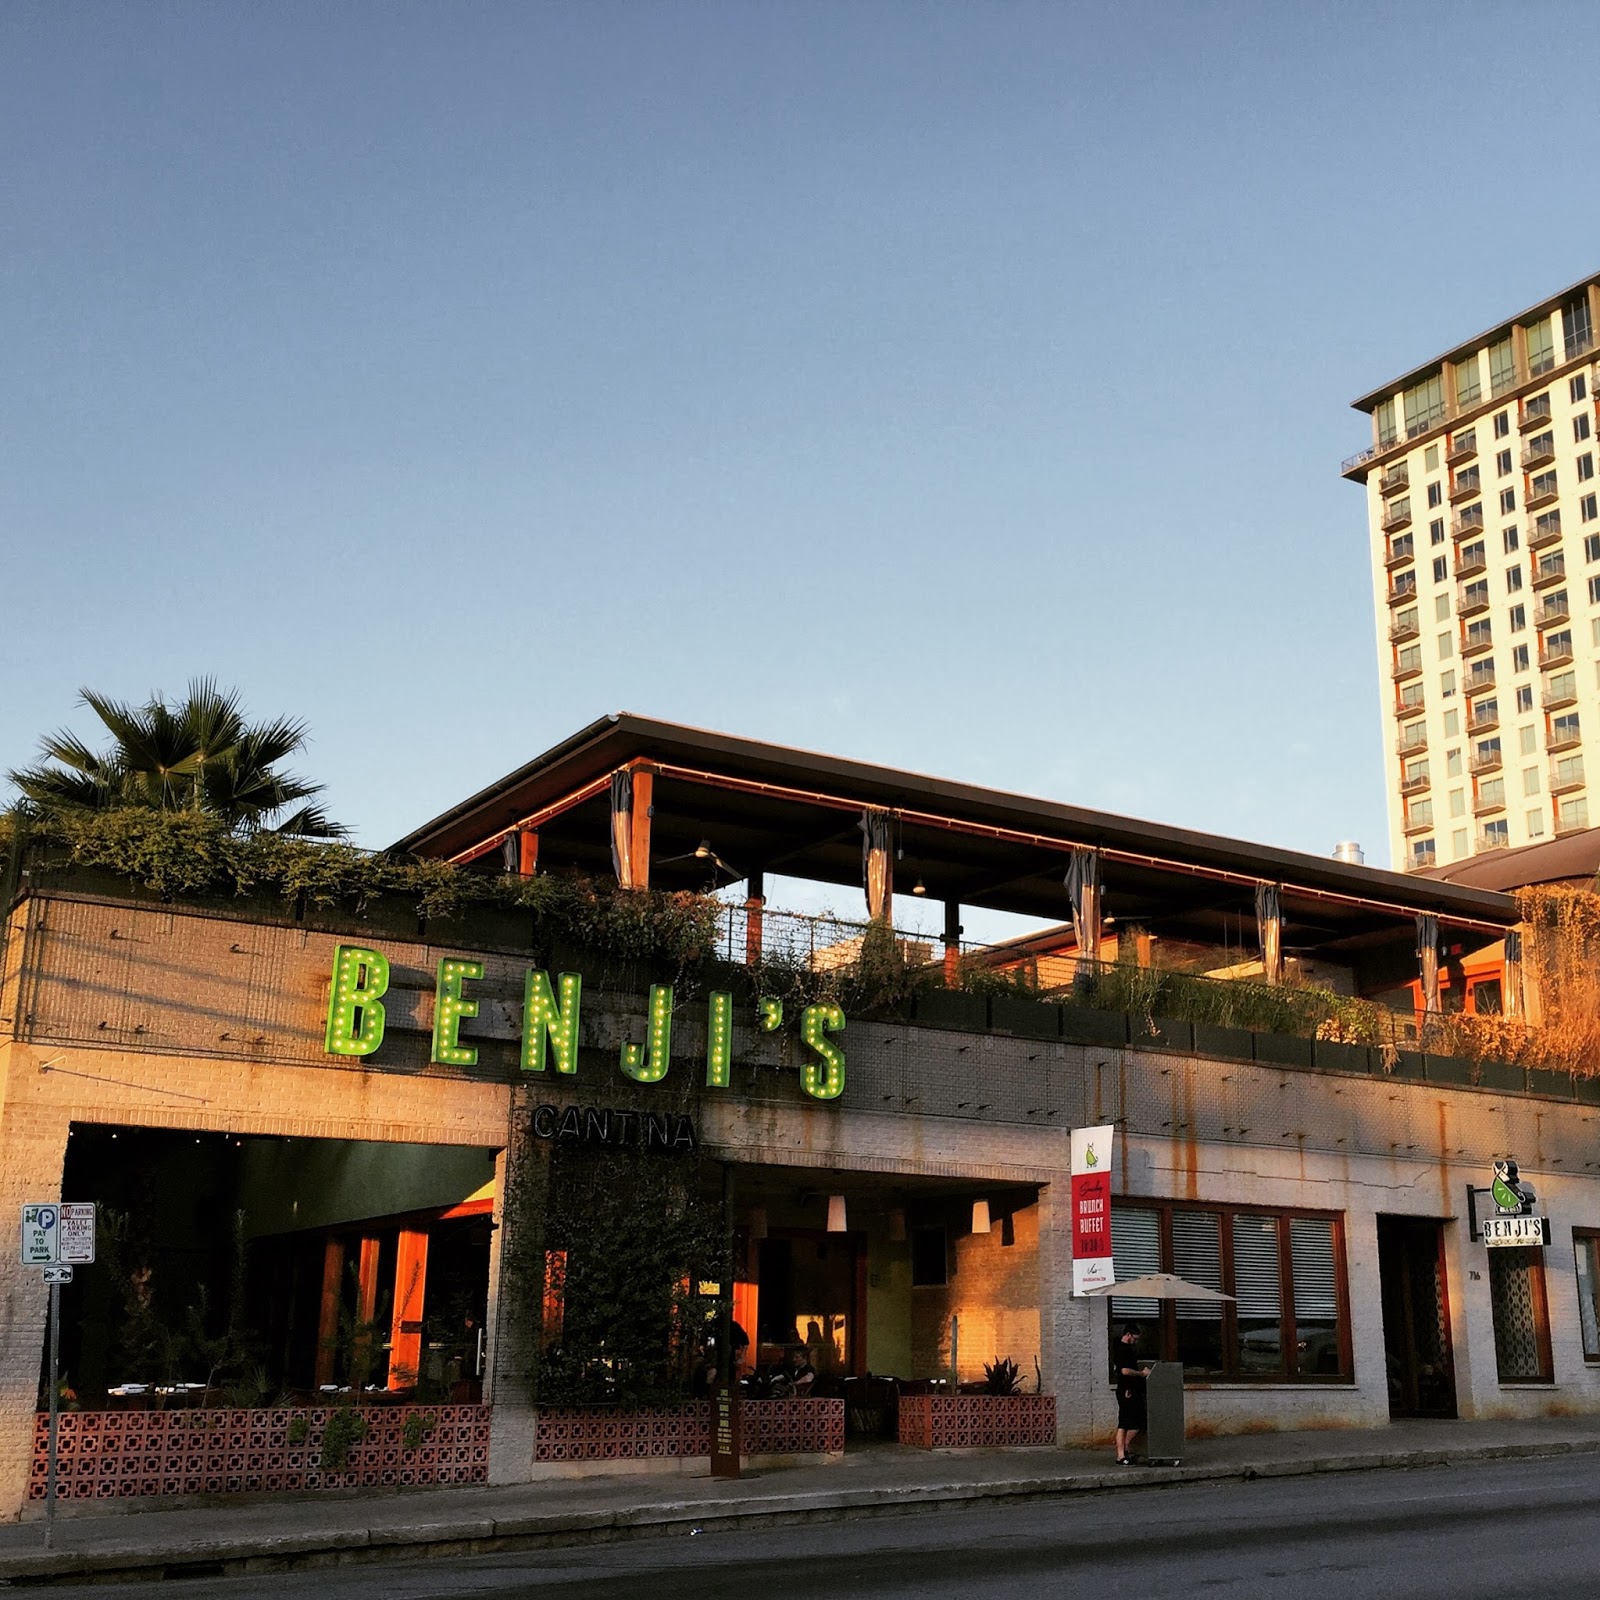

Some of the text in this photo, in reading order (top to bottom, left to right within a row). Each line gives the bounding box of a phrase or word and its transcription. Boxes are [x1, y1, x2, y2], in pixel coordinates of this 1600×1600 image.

[324, 944, 846, 1099] BENJI'S
[533, 1105, 696, 1152] CANTNA
[61, 1206, 93, 1218] NO PARKING
[1080, 1198, 1103, 1214] BRUNCH
[1080, 1217, 1103, 1233] BUFFET
[1484, 1219, 1541, 1237] BENJI'S
